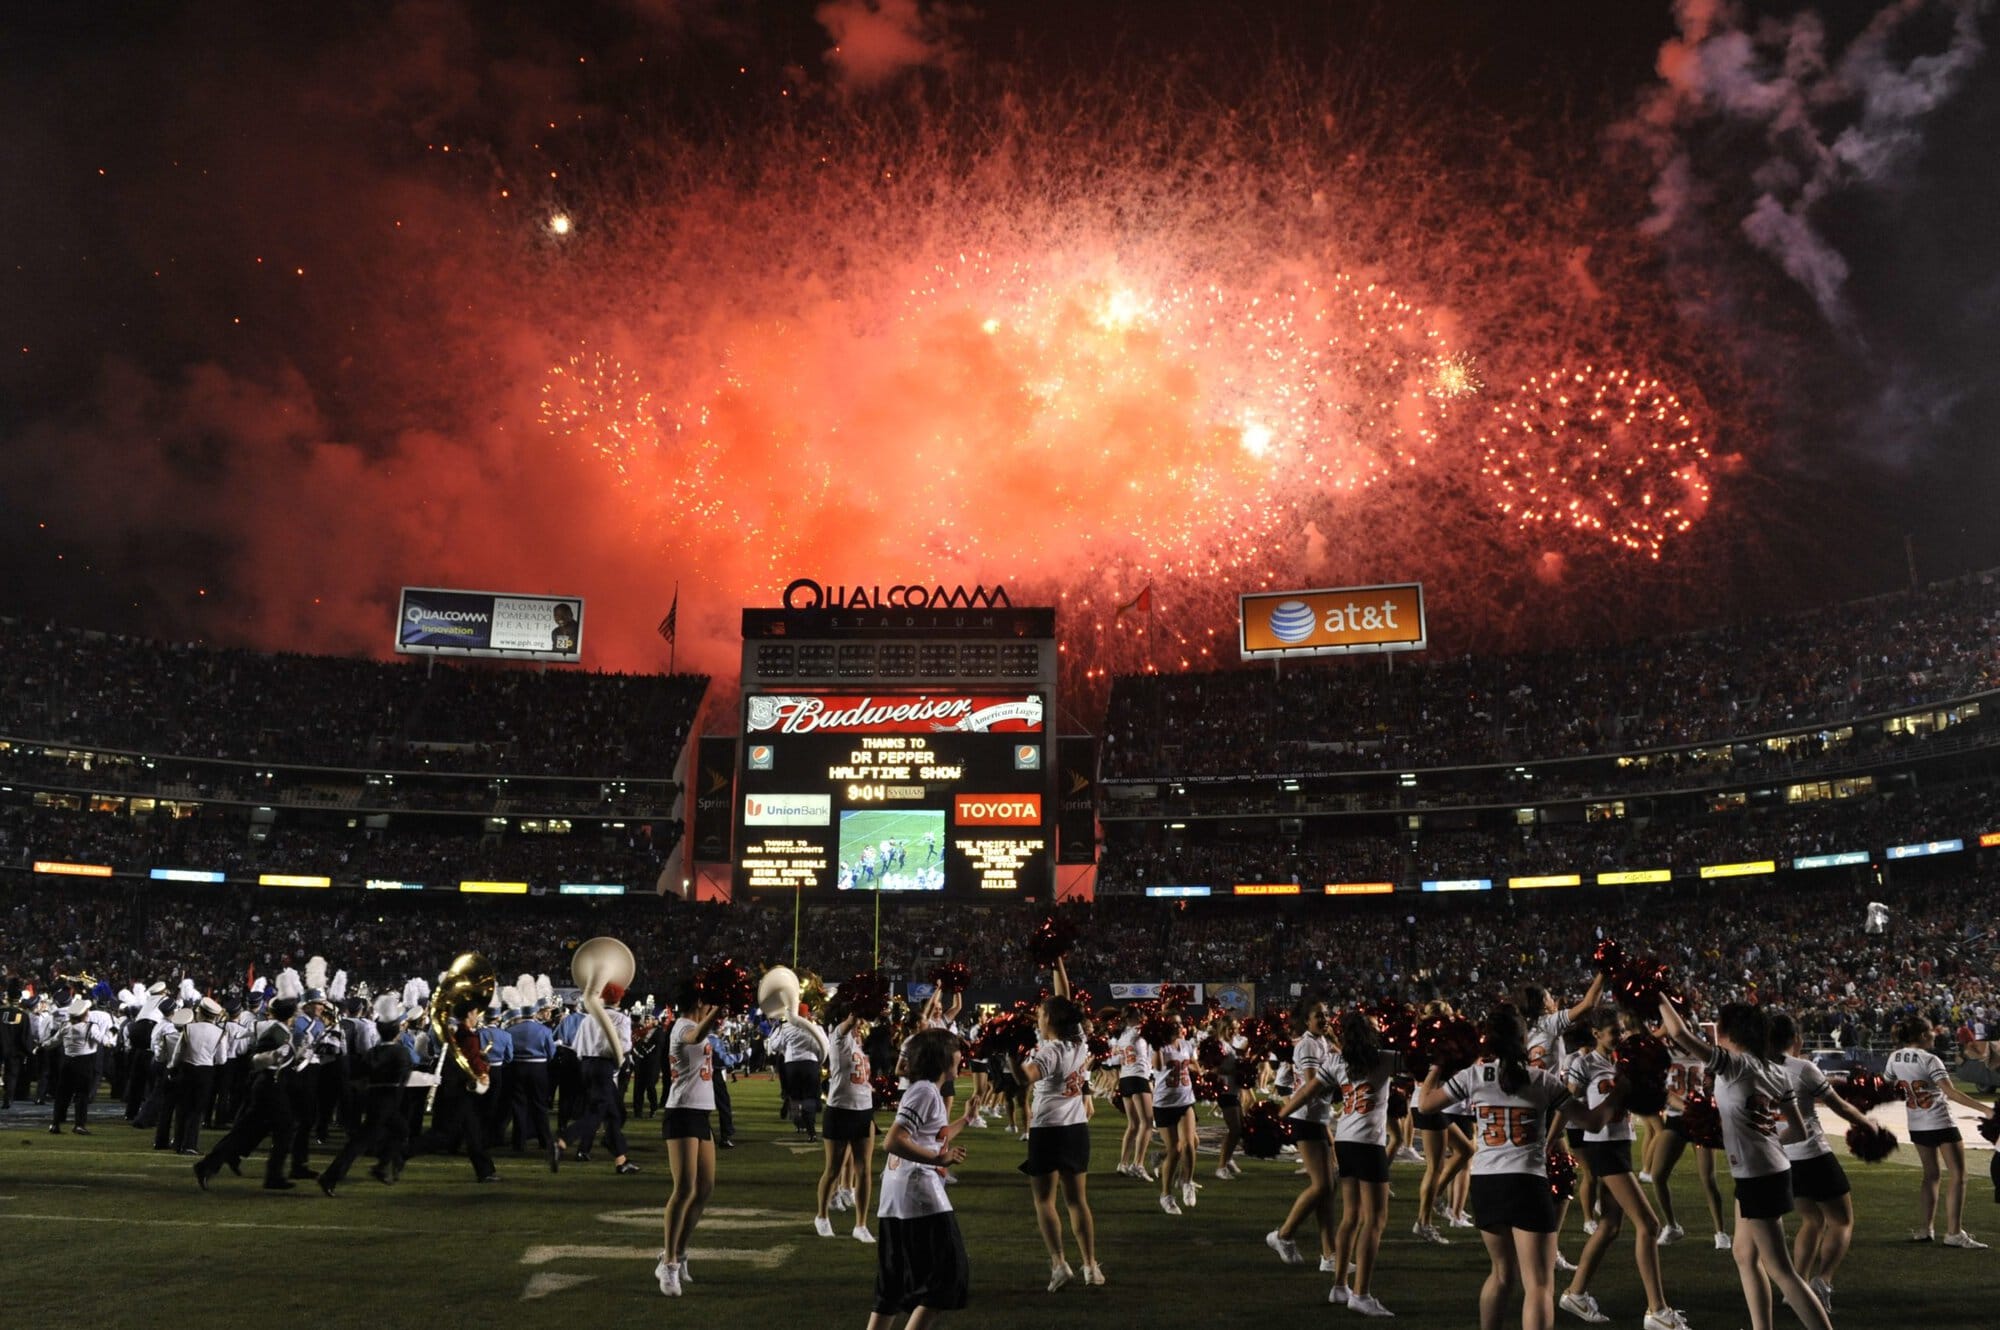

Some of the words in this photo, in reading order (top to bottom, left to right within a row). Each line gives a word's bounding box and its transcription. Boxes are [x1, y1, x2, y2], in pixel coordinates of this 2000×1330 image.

[783, 578, 1011, 608] QUALCOMM
[497, 602, 552, 612] PALOMAR
[407, 607, 488, 624] QUALCOMM
[497, 611, 552, 621] POMERADO
[831, 616, 993, 627] STADIUM
[1324, 600, 1398, 633] at&t
[496, 621, 552, 630] HEALTH
[776, 696, 971, 734] Budweiser
[974, 708, 1014, 726] American
[1015, 706, 1040, 717] Lager
[862, 738, 905, 748] THANKS
[911, 738, 926, 748] TO
[851, 752, 872, 764] DR
[878, 752, 935, 764] PEPPER
[829, 767, 910, 779] HALFTIME
[920, 767, 961, 779] SHOW
[848, 785, 885, 800] 9:04
[959, 803, 1037, 818] TOYOTA
[976, 840, 1016, 849] PACIFIC
[1020, 840, 1044, 849] LIFE
[1268, 885, 1299, 893] FARGO
[1479, 1106, 1537, 1147] 36
